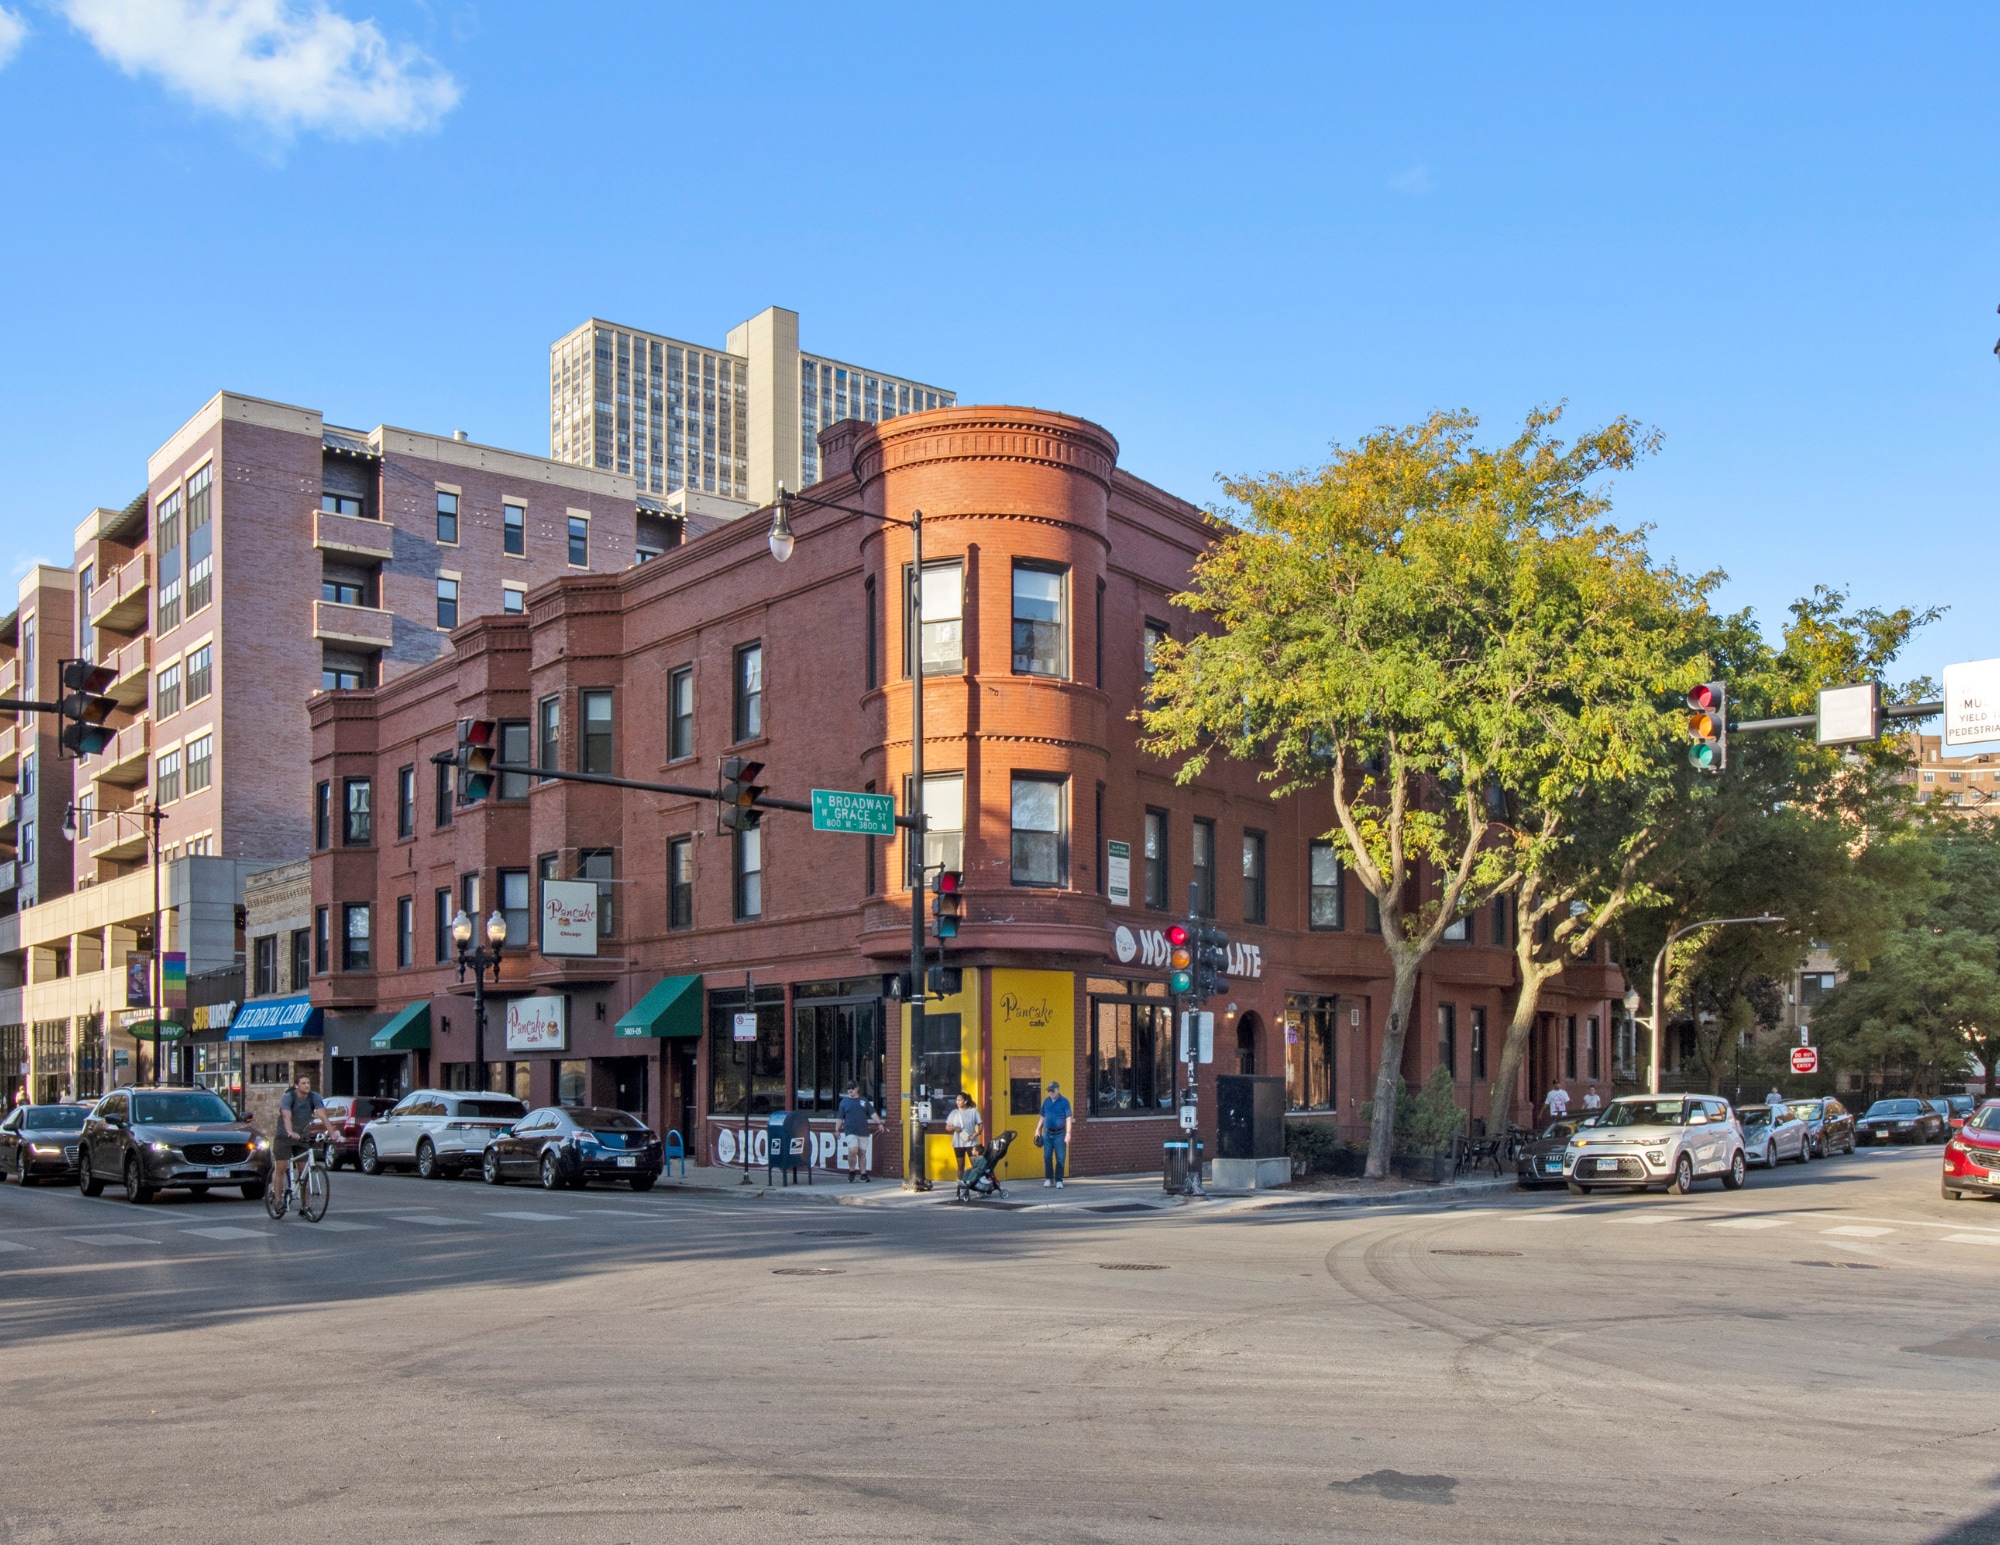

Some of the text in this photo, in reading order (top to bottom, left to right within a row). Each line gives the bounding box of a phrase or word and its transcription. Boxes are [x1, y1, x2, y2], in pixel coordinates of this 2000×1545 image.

[1959, 713, 1987, 722] YIELD
[816, 795, 890, 811] N BROADWAY
[821, 807, 887, 821] W GRACE ST
[826, 818, 841, 827] 800
[845, 820, 851, 828] W
[858, 821, 878, 830] 3800
[881, 823, 887, 831] N
[546, 898, 596, 921] Pancake
[1226, 942, 1262, 978] LATE
[192, 1000, 237, 1031] SUBWAY
[247, 1005, 285, 1027] DENTAL
[999, 991, 1054, 1024] Pancake
[508, 1006, 546, 1039] Pancake
[1029, 1018, 1045, 1027] cafe
[738, 1129, 769, 1165] NO
